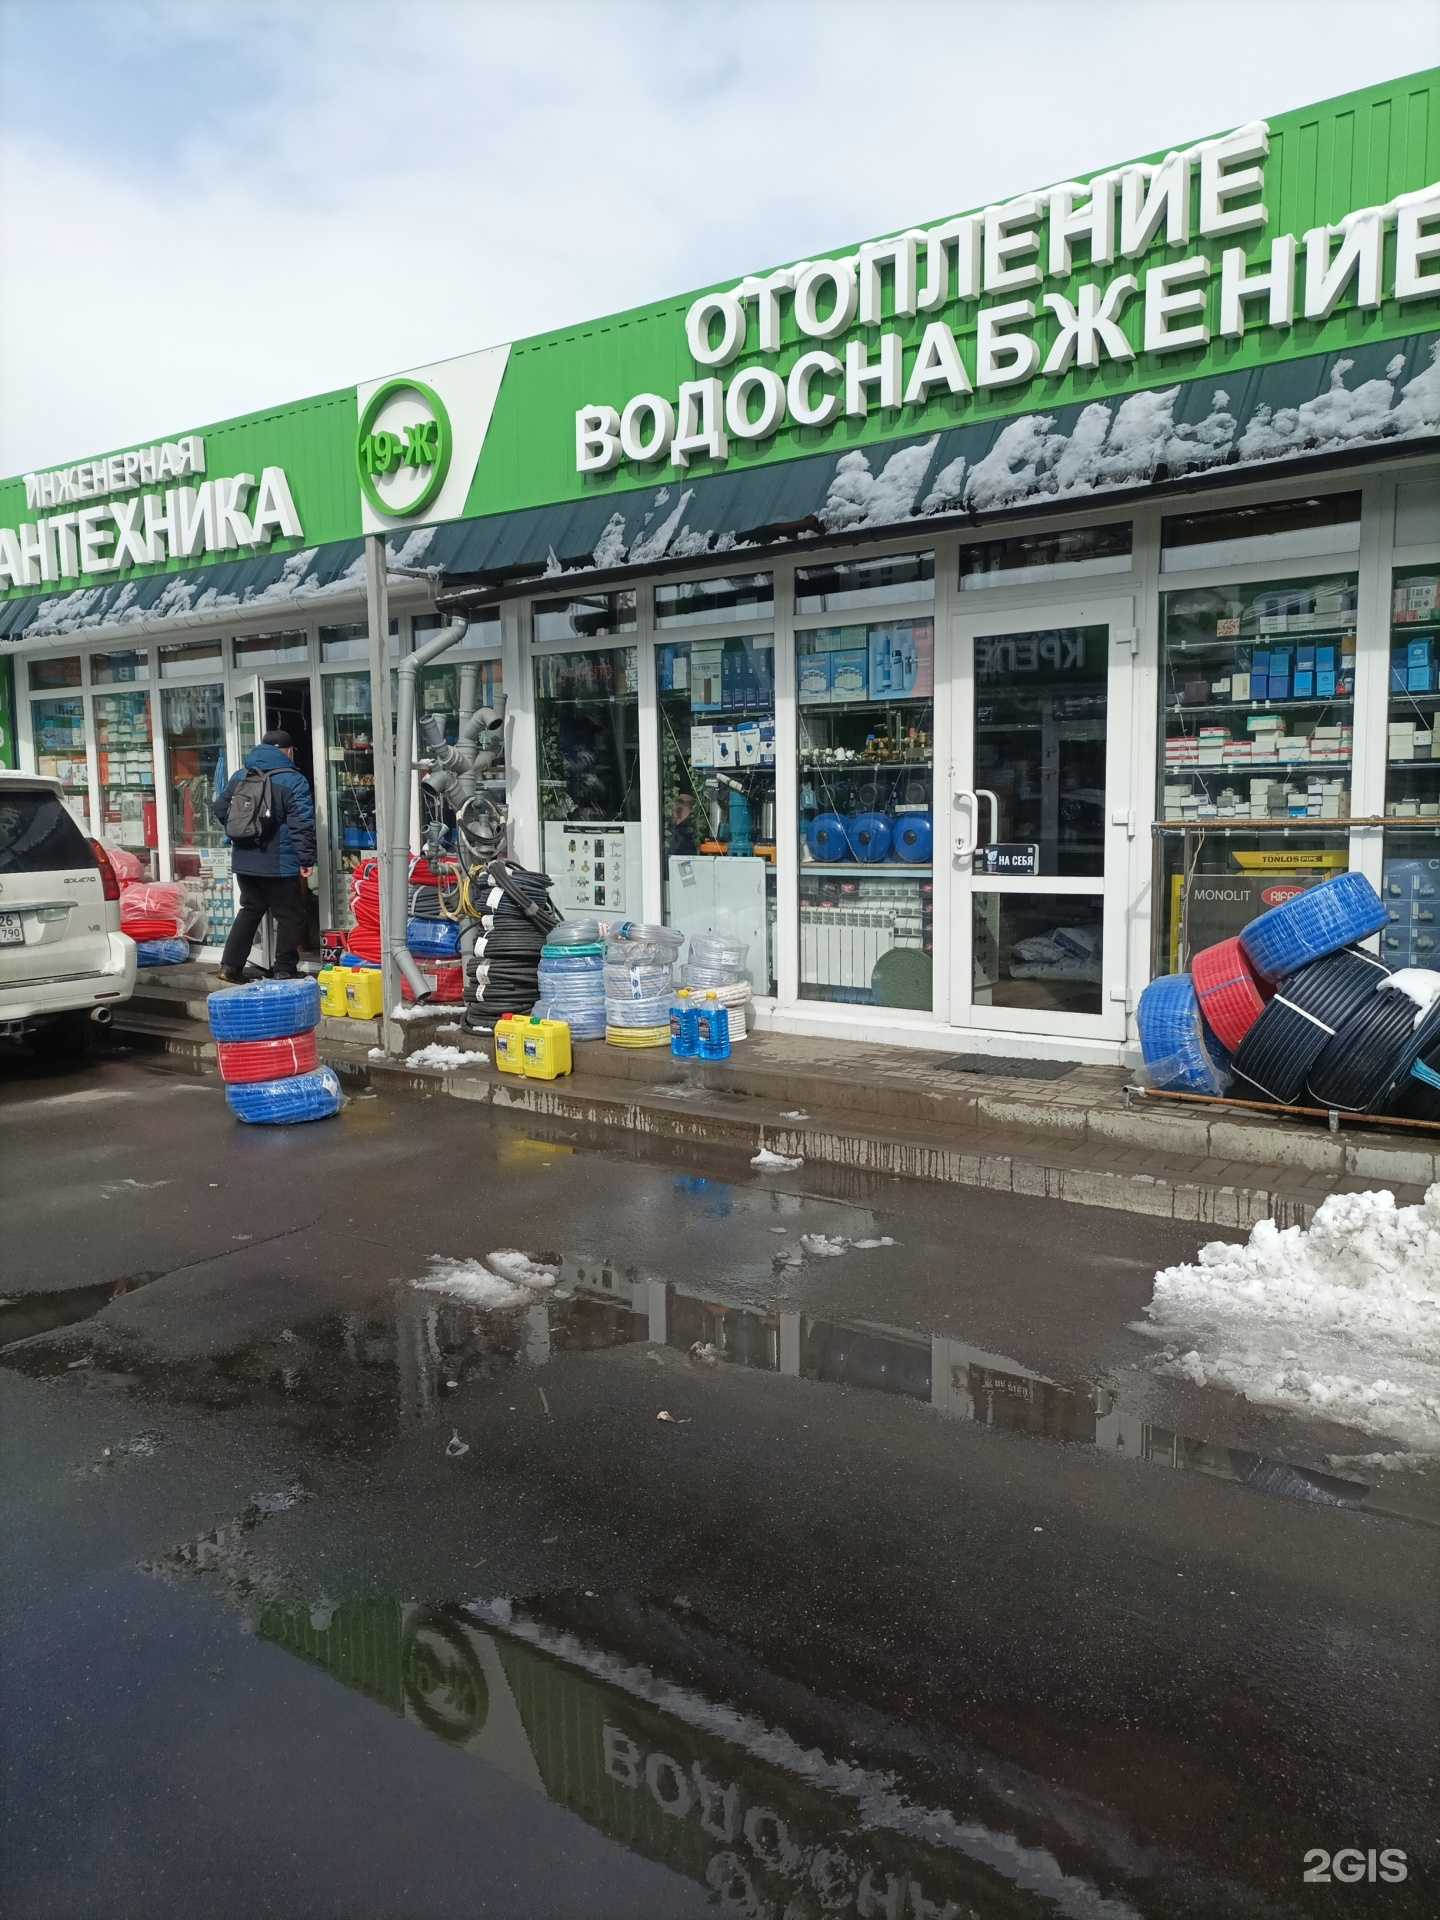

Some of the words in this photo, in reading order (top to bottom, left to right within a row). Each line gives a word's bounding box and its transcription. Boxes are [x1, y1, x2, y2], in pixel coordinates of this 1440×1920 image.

[685, 126, 1269, 367] ОТОПЛЕНИЕ
[575, 193, 1440, 473] ВОДОСНАБЖЕНИЕ
[24, 436, 206, 510] ИНЖЕНЕРНАЯ
[361, 422, 437, 475] 19-Ж
[998, 855, 1010, 866] НА
[1012, 855, 1034, 866] СЕБЯ
[1194, 889, 1251, 901] MONOLIT
[2, 928, 20, 938] 790
